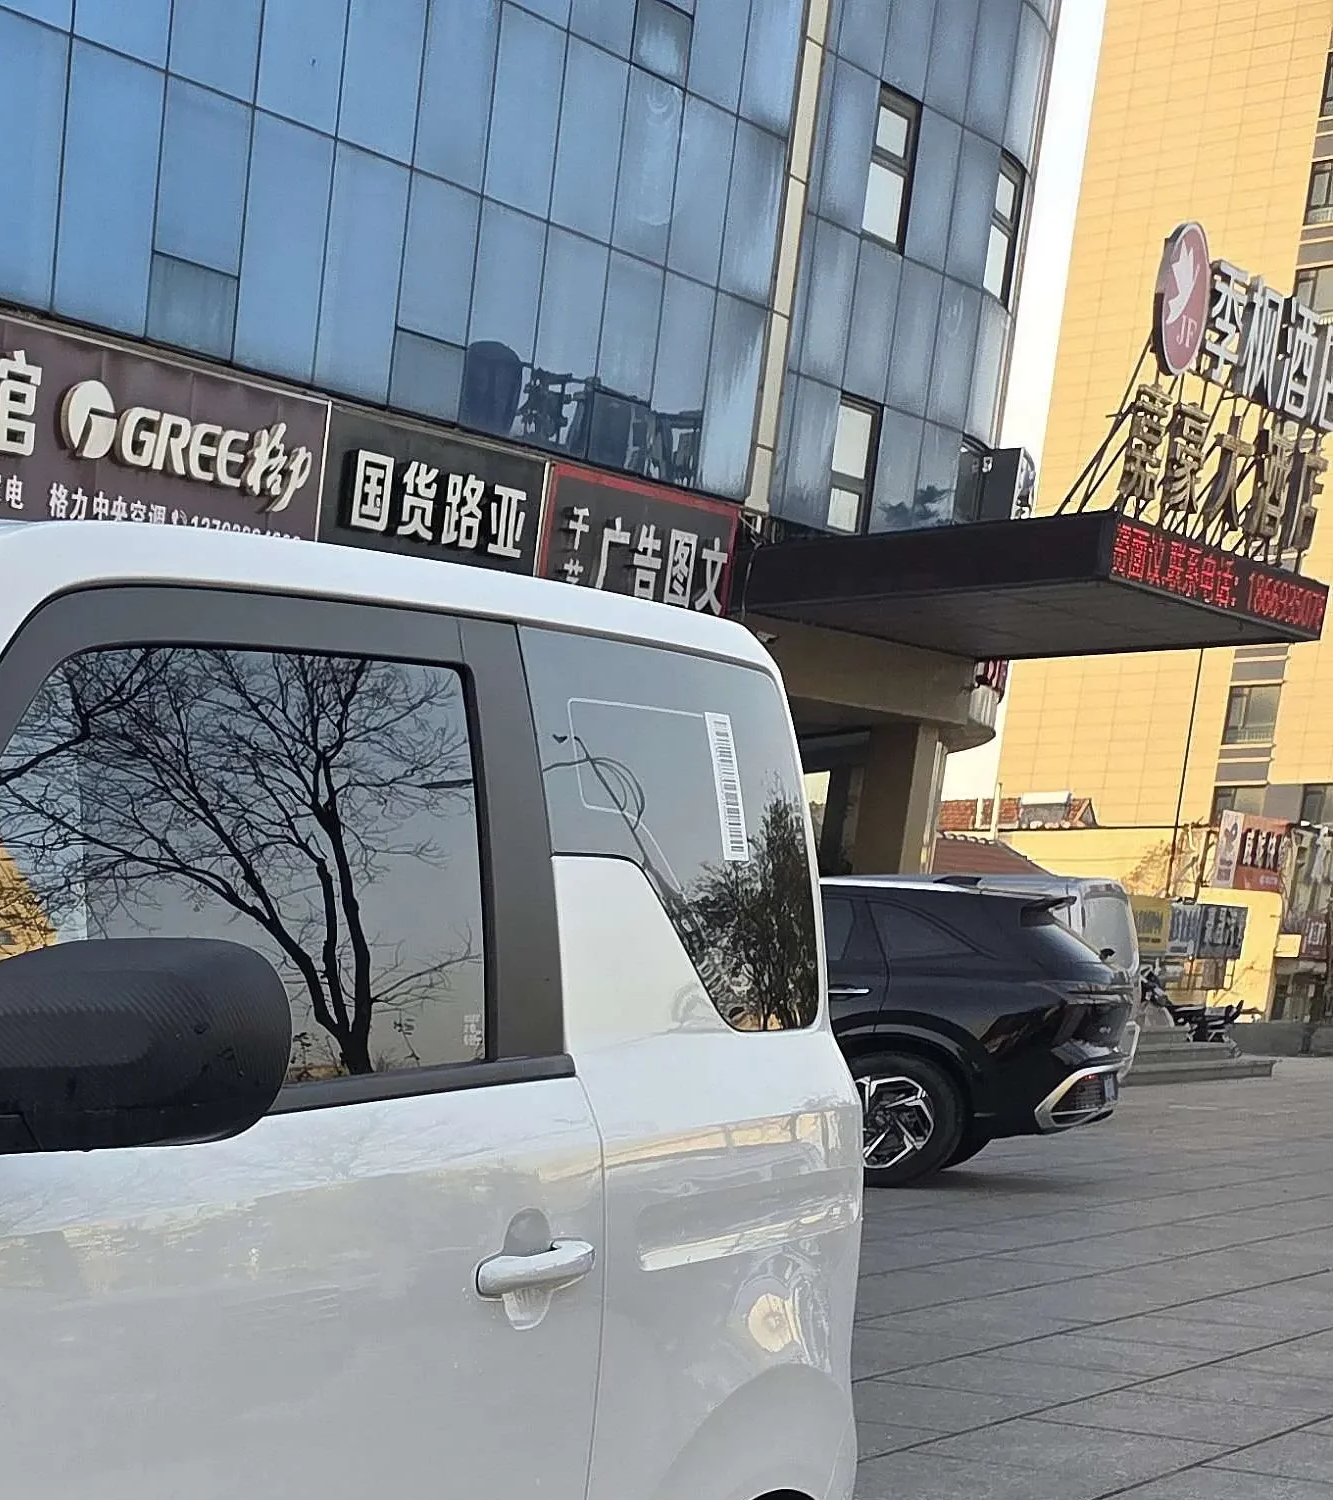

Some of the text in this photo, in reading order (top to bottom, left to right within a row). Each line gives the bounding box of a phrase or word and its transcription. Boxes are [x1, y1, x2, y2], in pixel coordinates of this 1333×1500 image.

[1176, 313, 1198, 350] JF
[120, 408, 249, 488] GREE
[352, 449, 528, 559] 国货路亚
[595, 516, 729, 616] 广告图文
